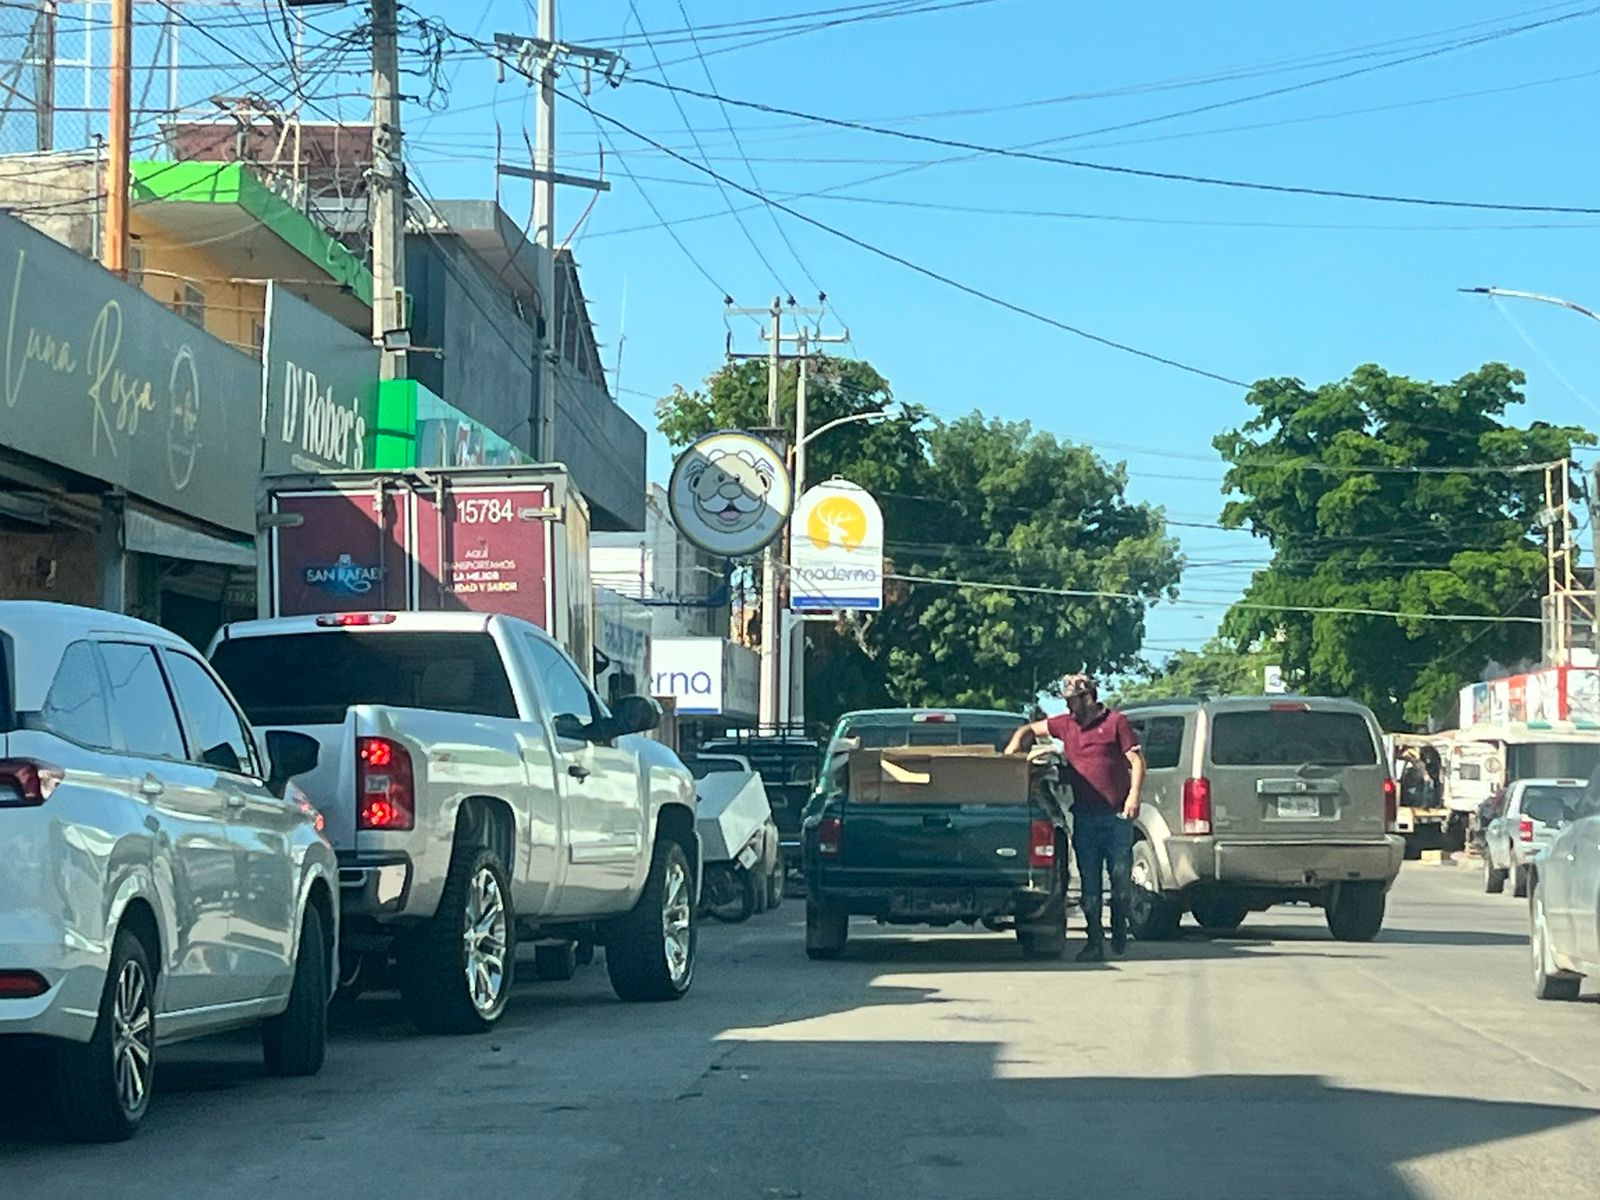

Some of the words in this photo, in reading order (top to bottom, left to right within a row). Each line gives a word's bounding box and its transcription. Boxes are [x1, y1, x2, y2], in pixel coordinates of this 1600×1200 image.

[5, 249, 77, 408] Luna
[456, 498, 514, 523] 15784
[306, 568, 336, 582] SAN
[443, 560, 516, 571] ANSPORTAMOS
[796, 566, 877, 581] moderna
[650, 670, 712, 695] rna
